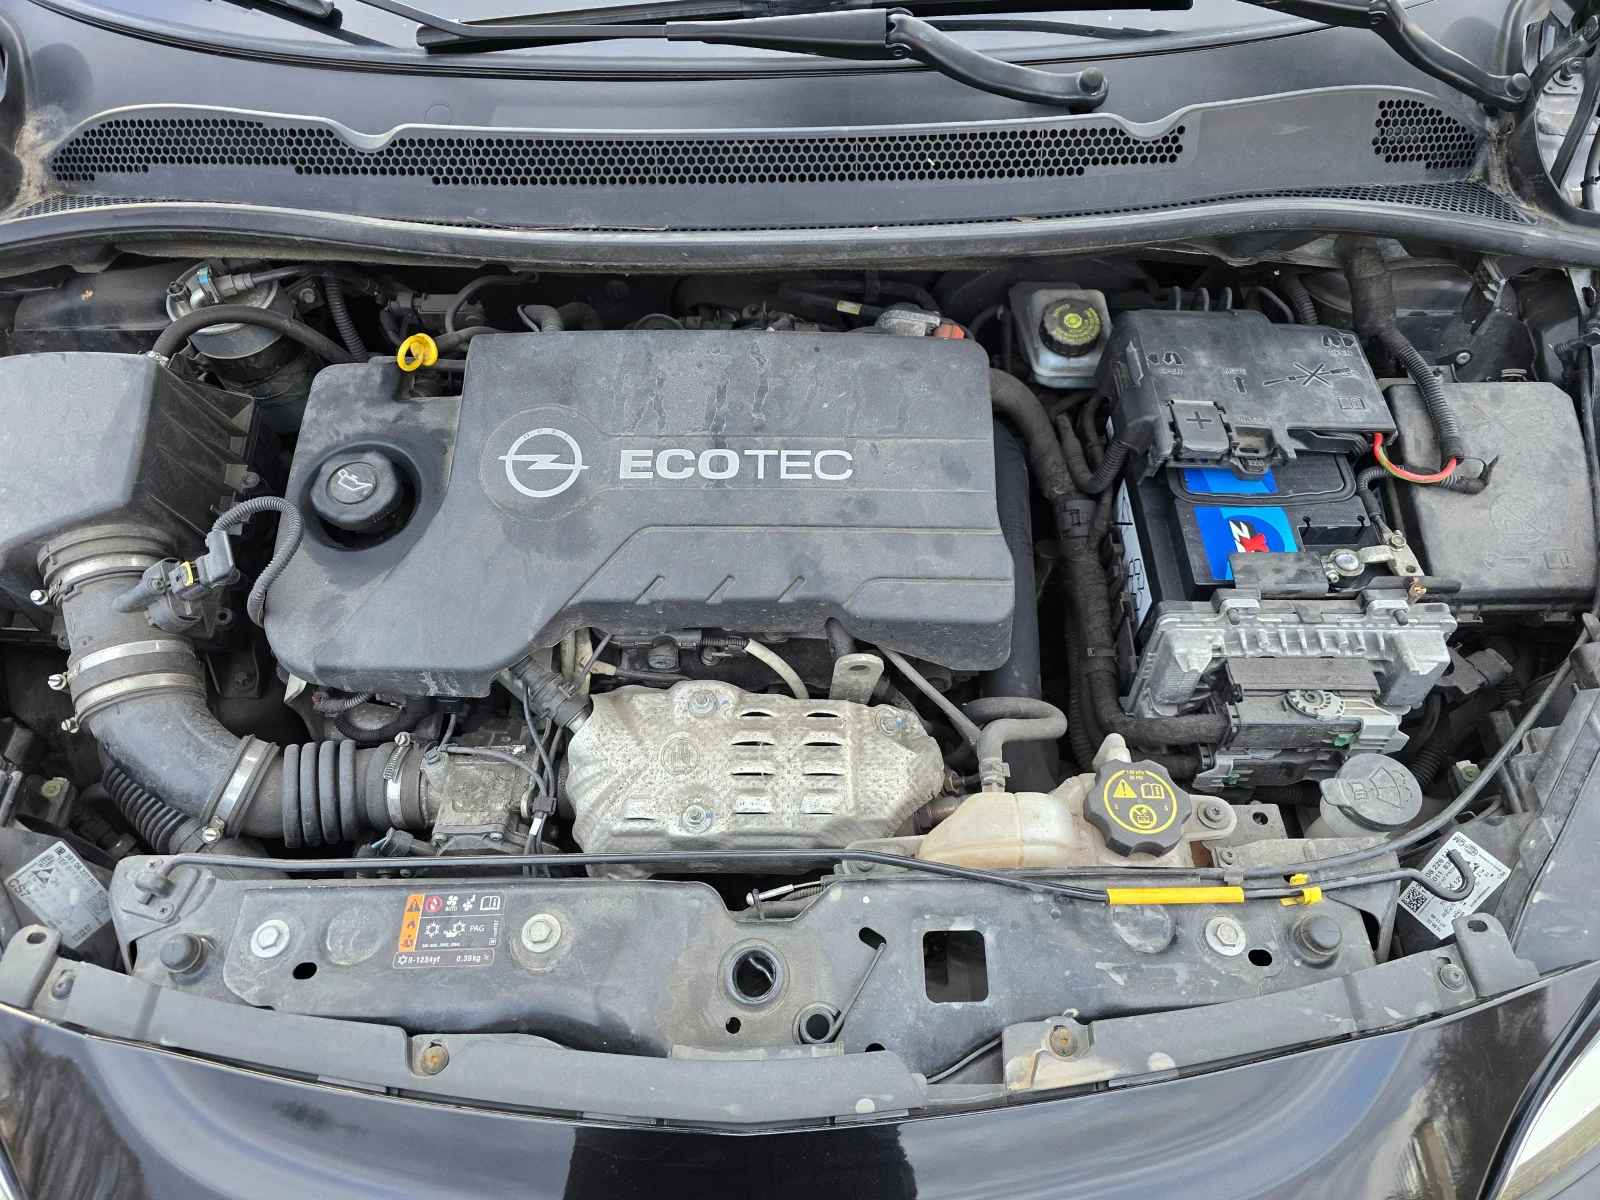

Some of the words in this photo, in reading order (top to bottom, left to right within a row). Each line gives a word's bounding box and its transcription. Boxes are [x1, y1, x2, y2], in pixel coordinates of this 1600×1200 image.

[619, 449, 854, 481] ECOTEC
[8, 878, 31, 897] CS7
[80, 871, 90, 880] 227
[89, 878, 98, 887] RH
[408, 956, 440, 964] R-1234yf
